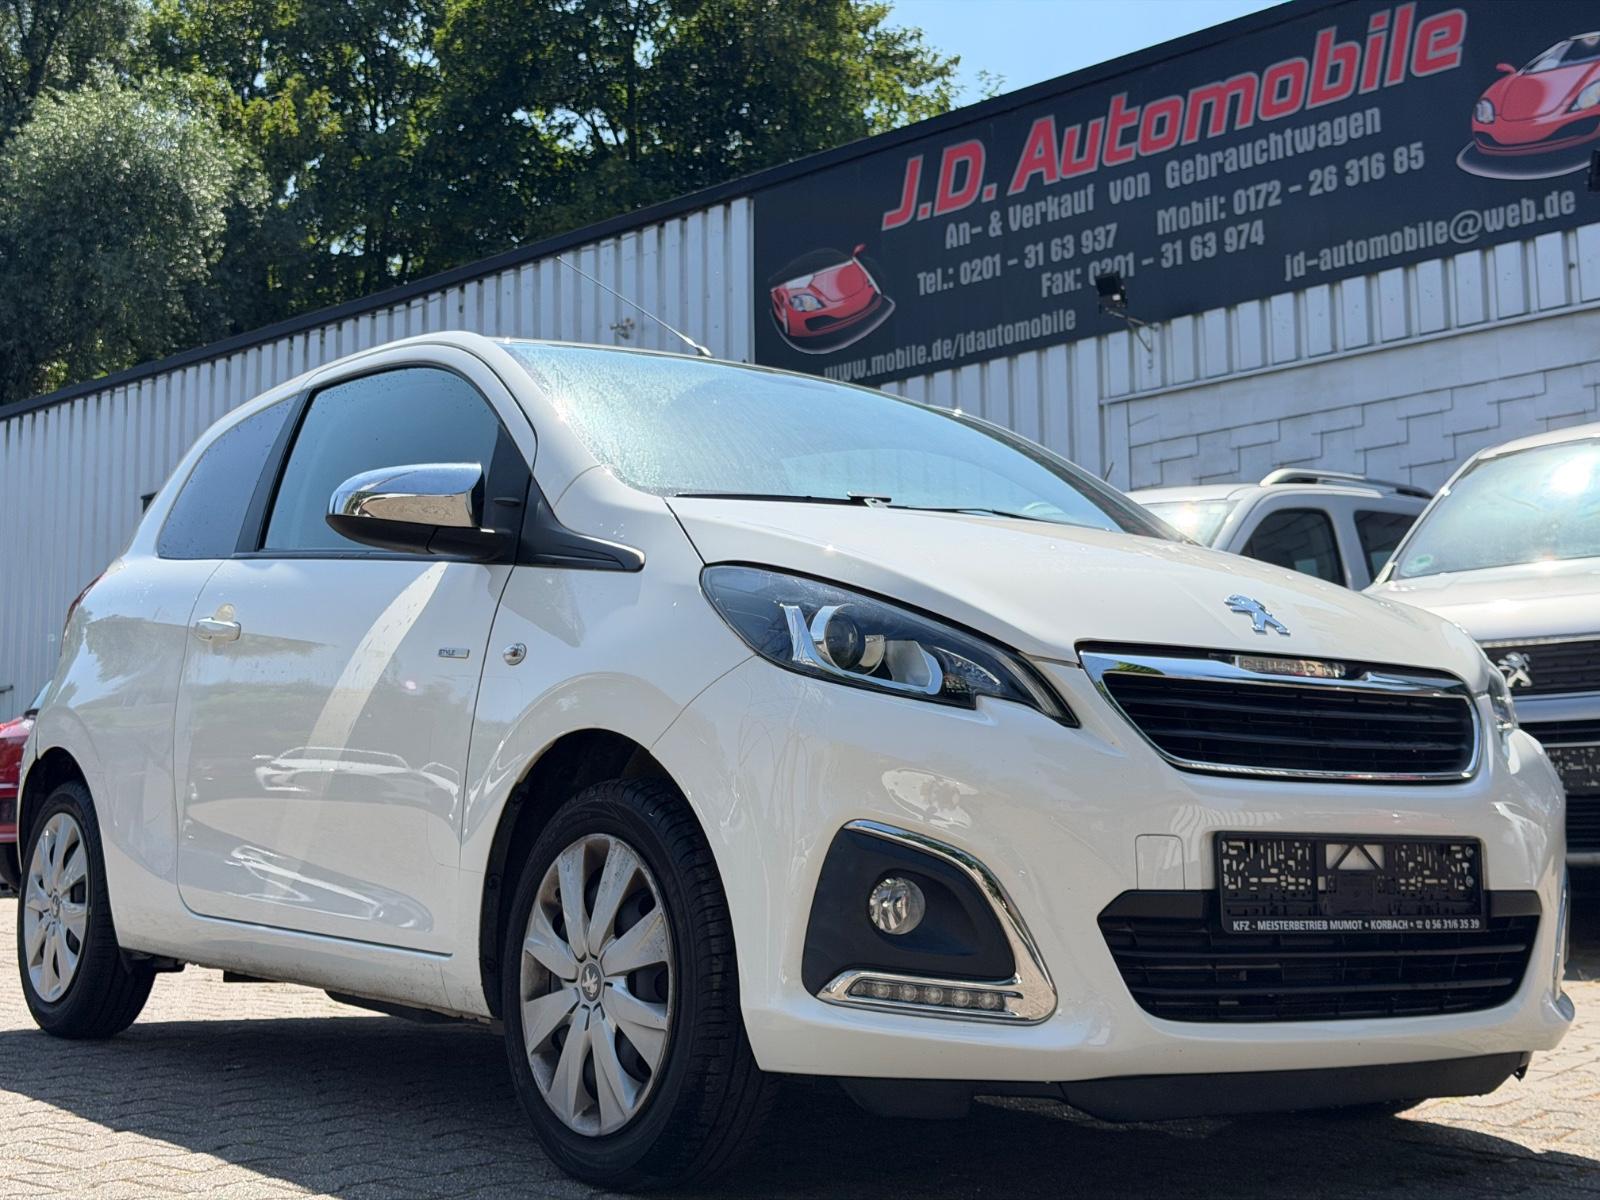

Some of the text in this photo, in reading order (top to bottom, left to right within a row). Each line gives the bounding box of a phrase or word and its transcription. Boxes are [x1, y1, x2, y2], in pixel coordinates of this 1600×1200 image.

[882, 2, 1467, 231] J.D. Automobile
[945, 106, 1381, 250] An- & Verkauf von Gebrauchtwagen
[1157, 196, 1226, 236] Mobil:
[1233, 179, 1282, 217] 0172
[1308, 166, 1338, 198] 26
[1345, 152, 1385, 188] 316
[1393, 142, 1425, 175] 85
[917, 265, 954, 296] Tel.:
[959, 257, 1001, 286] 0201
[1024, 242, 1044, 270] 31
[1050, 234, 1075, 263] 63
[1081, 223, 1118, 256] 937
[1041, 267, 1082, 298] Fax:
[1160, 237, 1183, 269] 31
[1190, 229, 1218, 262] 63
[1223, 220, 1265, 255] 974
[1284, 190, 1576, 283] jd-automobile@web.de
[1232, 920, 1250, 931] KFZ
[1257, 920, 1328, 931] MEISTERBETRIEB
[1330, 920, 1363, 930] MUMOT
[1370, 920, 1408, 930] KORBACH
